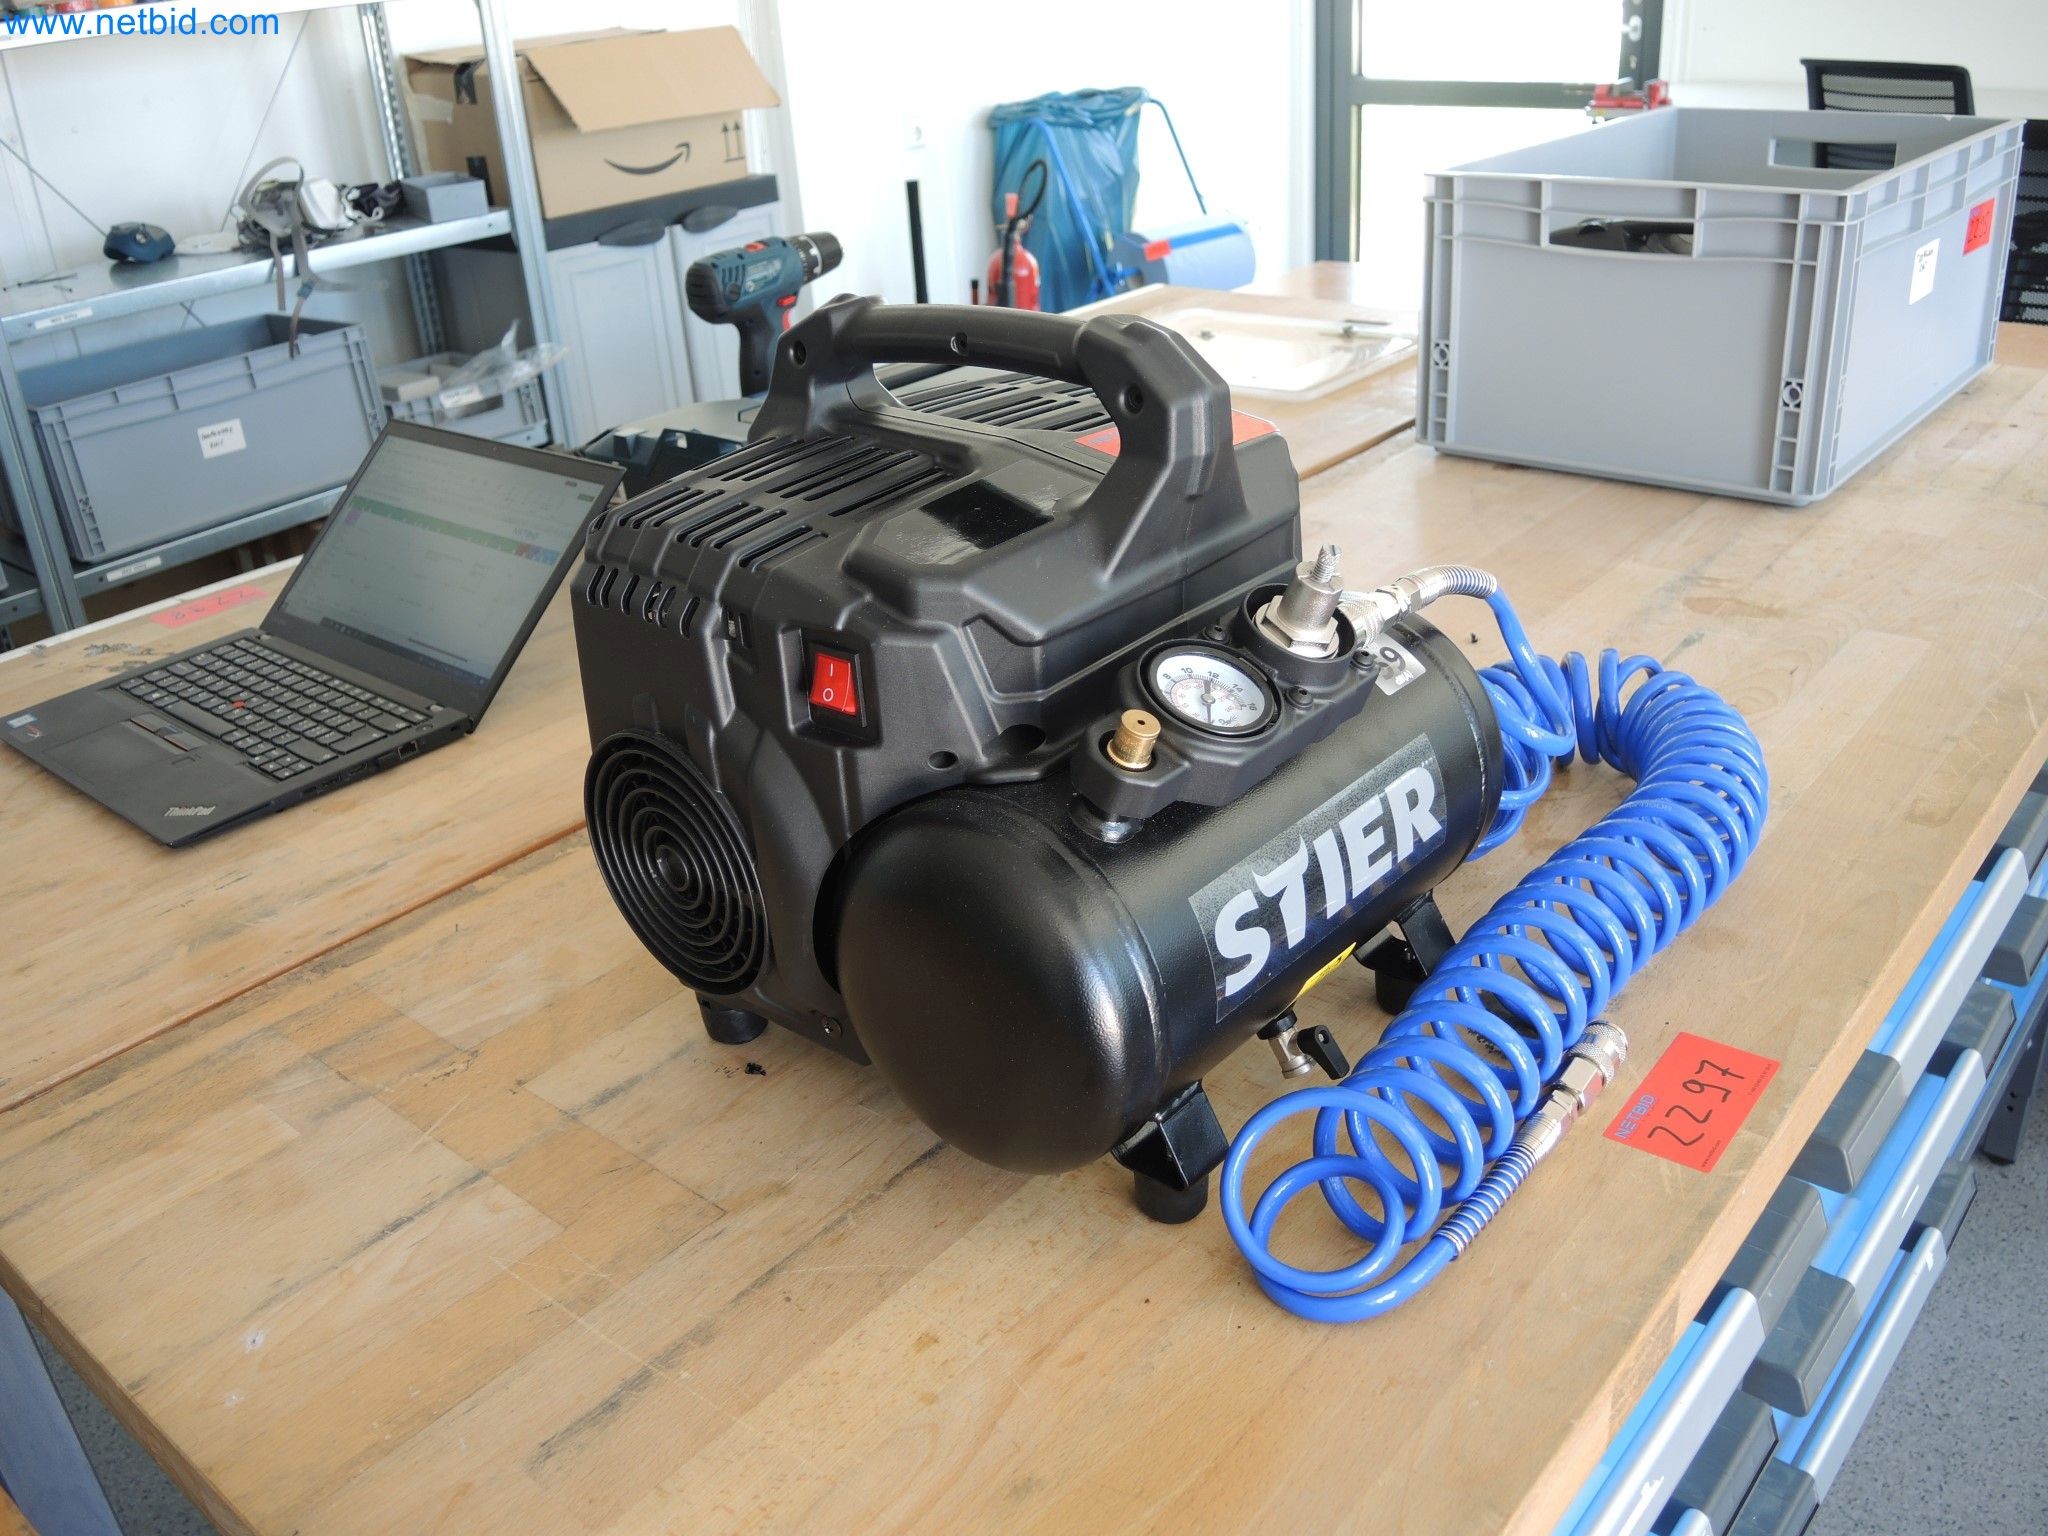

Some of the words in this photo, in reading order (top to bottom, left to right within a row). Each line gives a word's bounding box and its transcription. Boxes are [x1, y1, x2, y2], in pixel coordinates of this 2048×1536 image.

[1181, 667, 1194, 675] 10
[1231, 683, 1244, 693] 14
[164, 806, 216, 817] ThinkPad
[1215, 766, 1442, 996] STIER
[1614, 1094, 1657, 1140] NETBID
[1647, 1059, 1745, 1147] 2297
